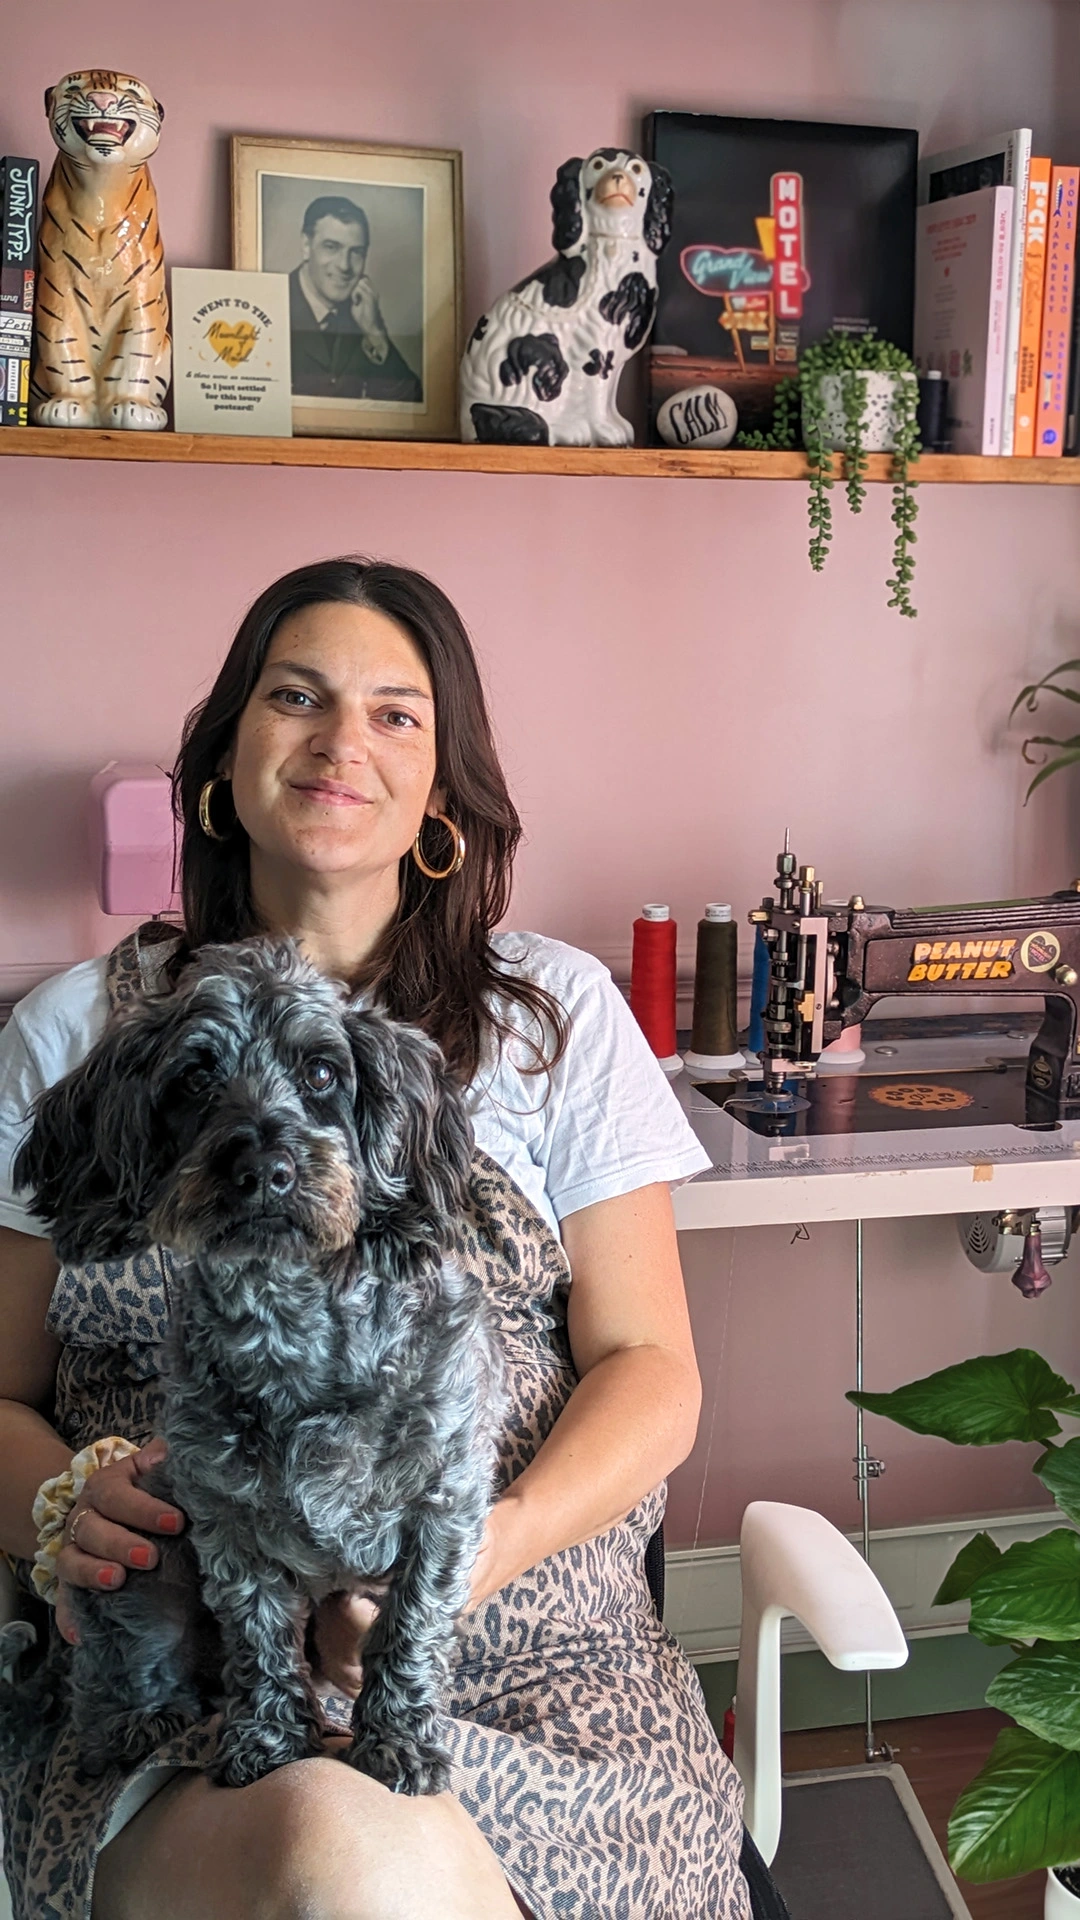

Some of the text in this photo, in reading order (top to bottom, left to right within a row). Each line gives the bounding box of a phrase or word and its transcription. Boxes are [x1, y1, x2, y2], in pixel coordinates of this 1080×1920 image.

[9, 166, 35, 218] JUNK
[7, 211, 33, 261] TYPE
[778, 177, 799, 315] MOTEL
[692, 251, 748, 285] Grand
[729, 257, 773, 290] View
[1047, 220, 1060, 313] JAPANEASY
[1060, 263, 1070, 314] BENTO
[192, 298, 273, 328] I WENT TO THE
[1045, 330, 1053, 359] TIM
[201, 382, 211, 390] So
[218, 383, 235, 391] just
[1019, 346, 1029, 394] BRONSON
[1054, 331, 1066, 412] ANDERSON
[205, 392, 218, 400] for
[239, 394, 262, 403] lousy
[669, 392, 728, 444] CALM
[907, 960, 1012, 981] BUTTER
[914, 939, 1017, 961] PEANUT
